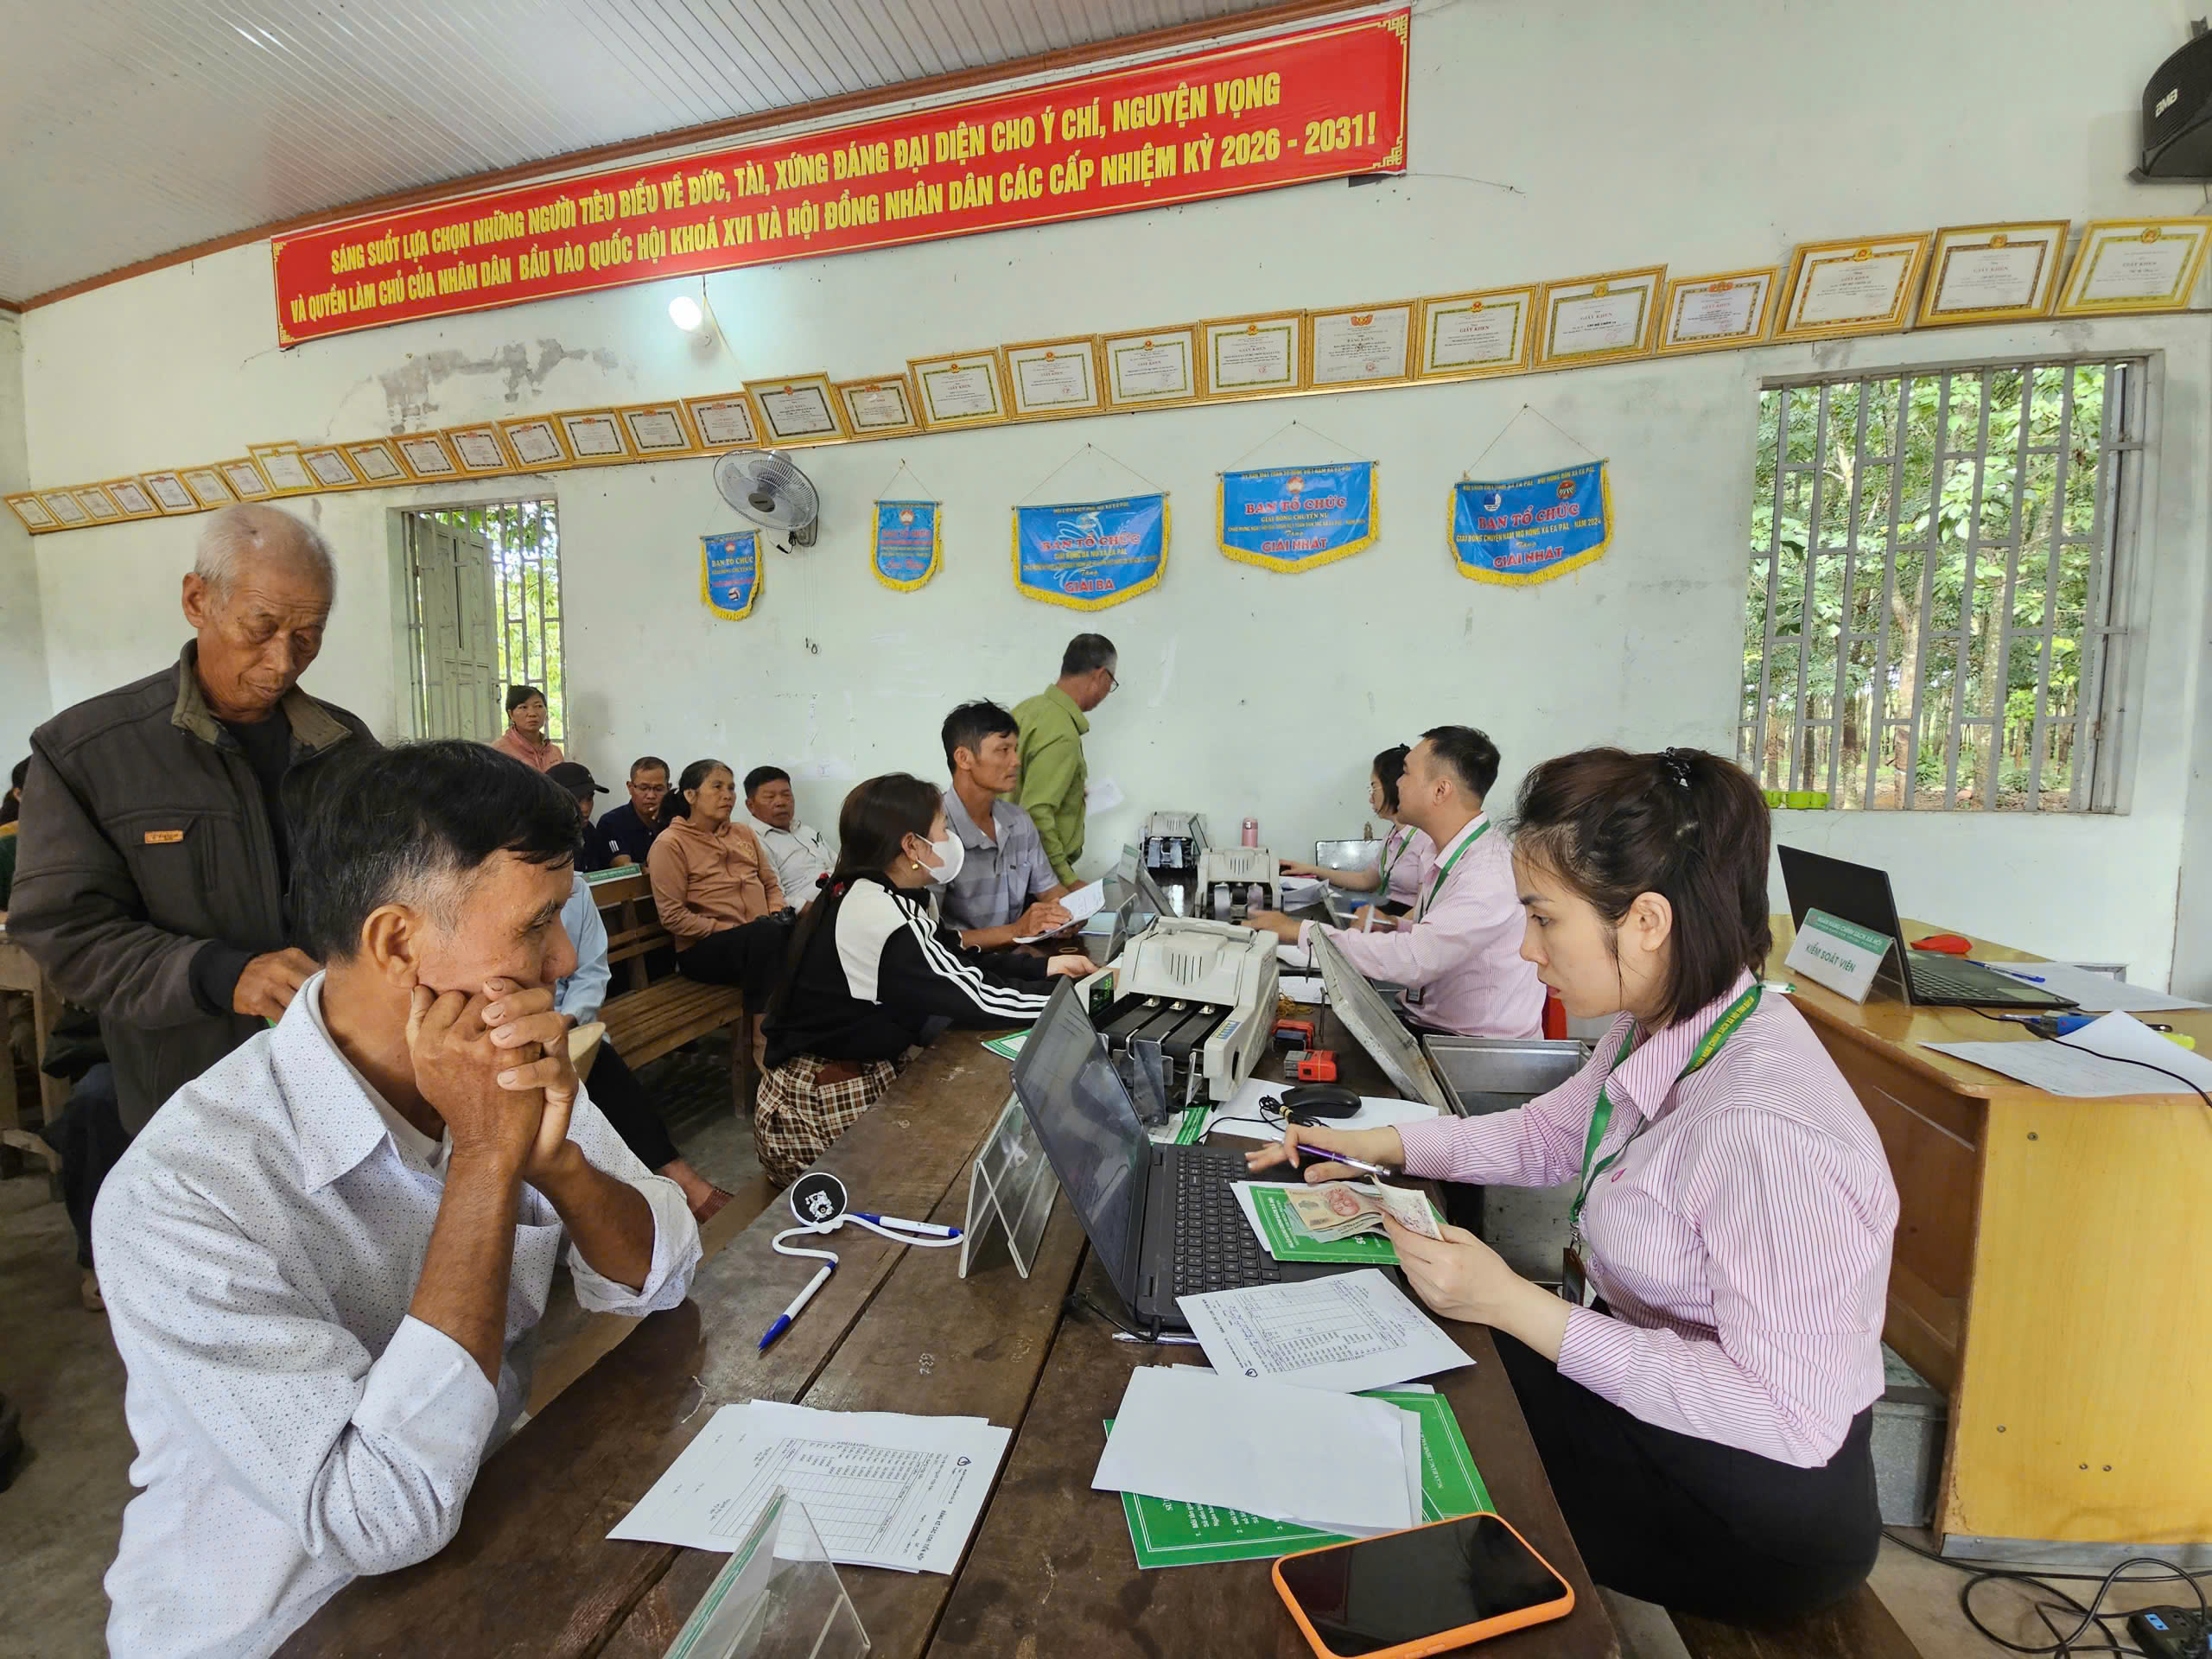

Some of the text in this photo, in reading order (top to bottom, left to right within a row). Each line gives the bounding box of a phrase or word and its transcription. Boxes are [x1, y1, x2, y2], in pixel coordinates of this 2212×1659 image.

[331, 73, 1280, 274] SÁNG SUỐT LỰA CHỌN NHỮNG NGƯỜI TIÊU BIỂU VỀ ĐỨC, TÀI, XỨNG ĐÁNG ĐẠI DIỆN CHO Ý CHÍ, NGUYỆN VỌNG
[290, 298, 307, 322] VÀ
[308, 287, 347, 321] QUYỀN
[348, 283, 377, 312] LÀM
[378, 271, 405, 305] CHỦ
[407, 267, 436, 301] CỦA
[438, 262, 478, 295] NHÂN
[481, 255, 512, 288] DÂN
[519, 245, 550, 280] BẦU
[553, 241, 585, 274] VÀO
[588, 231, 632, 270] QUỐC
[637, 227, 666, 264] HỘI
[670, 217, 720, 255] KHOÁ
[723, 216, 753, 246] XVI
[757, 207, 782, 241] VÀ
[787, 200, 820, 239] HỘI
[823, 189, 880, 229] ĐỒNG
[884, 181, 943, 221] NHÂN
[949, 172, 994, 211] DÂN
[1000, 164, 1043, 202] CÁC
[1050, 151, 1094, 194] CẤP
[1102, 143, 1176, 188] NHIỆM
[1184, 132, 1214, 174] KỲ
[1221, 129, 1280, 168] 2026
[1305, 111, 1376, 155] 2031!
[1245, 494, 1347, 515] BAN TỔ CHỨC
[1478, 501, 1580, 531] BAN TỔ CHỨC
[1042, 532, 1141, 552] BAN TỔ CHỨC
[1525, 546, 1563, 564] NHẤT
[1096, 578, 1115, 592] BA
[1805, 942, 1857, 973] KIỂM SOÁT VIÊN
